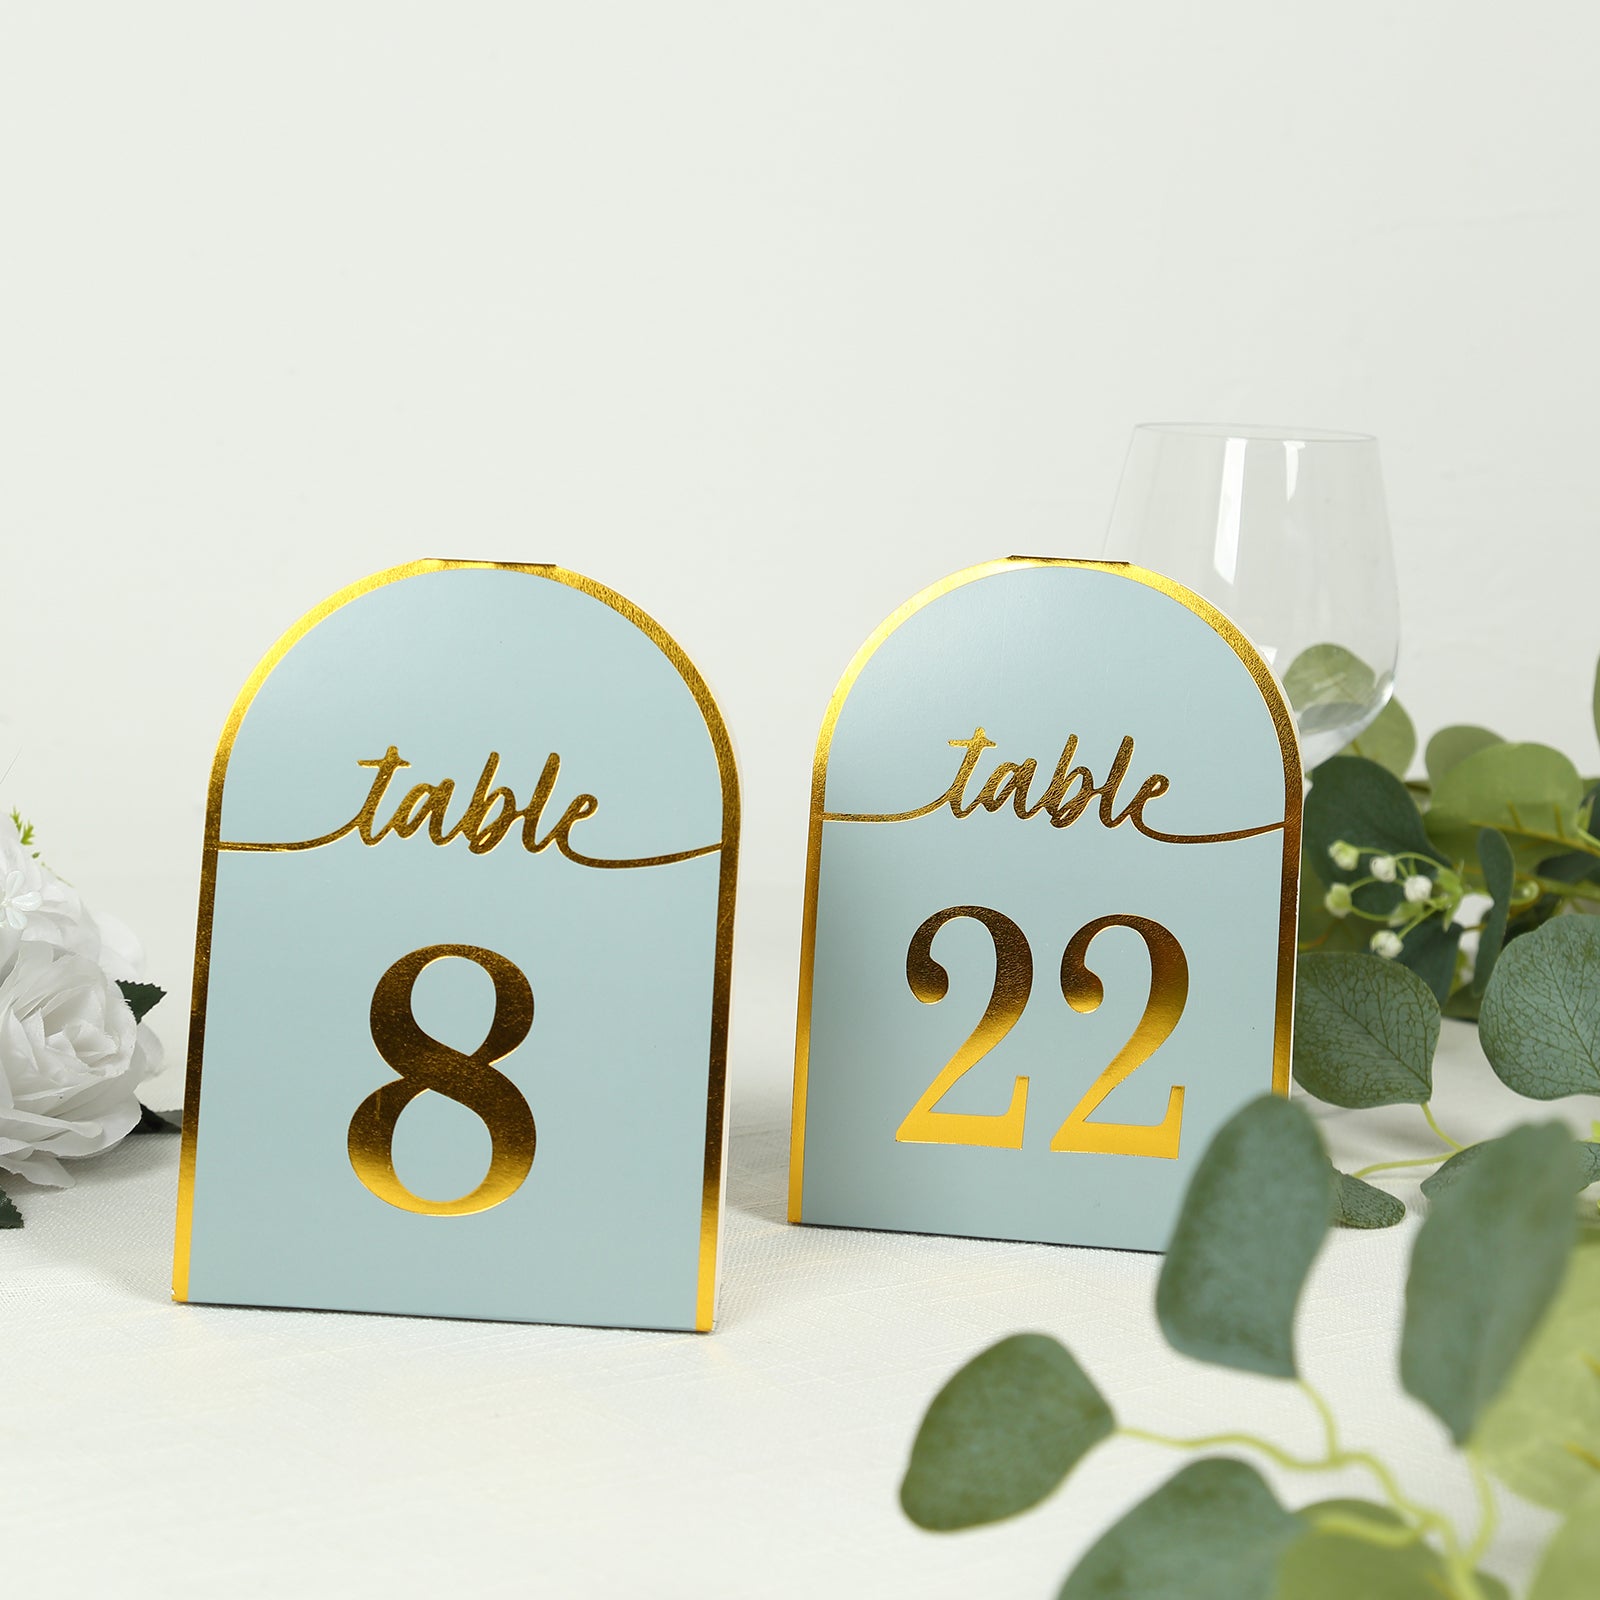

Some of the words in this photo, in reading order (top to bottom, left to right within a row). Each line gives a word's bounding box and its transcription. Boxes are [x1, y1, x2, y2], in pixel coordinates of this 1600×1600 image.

[356, 745, 600, 856] table
[947, 725, 1171, 831] table
[347, 943, 538, 1217] 8
[896, 905, 1190, 1160] 22
